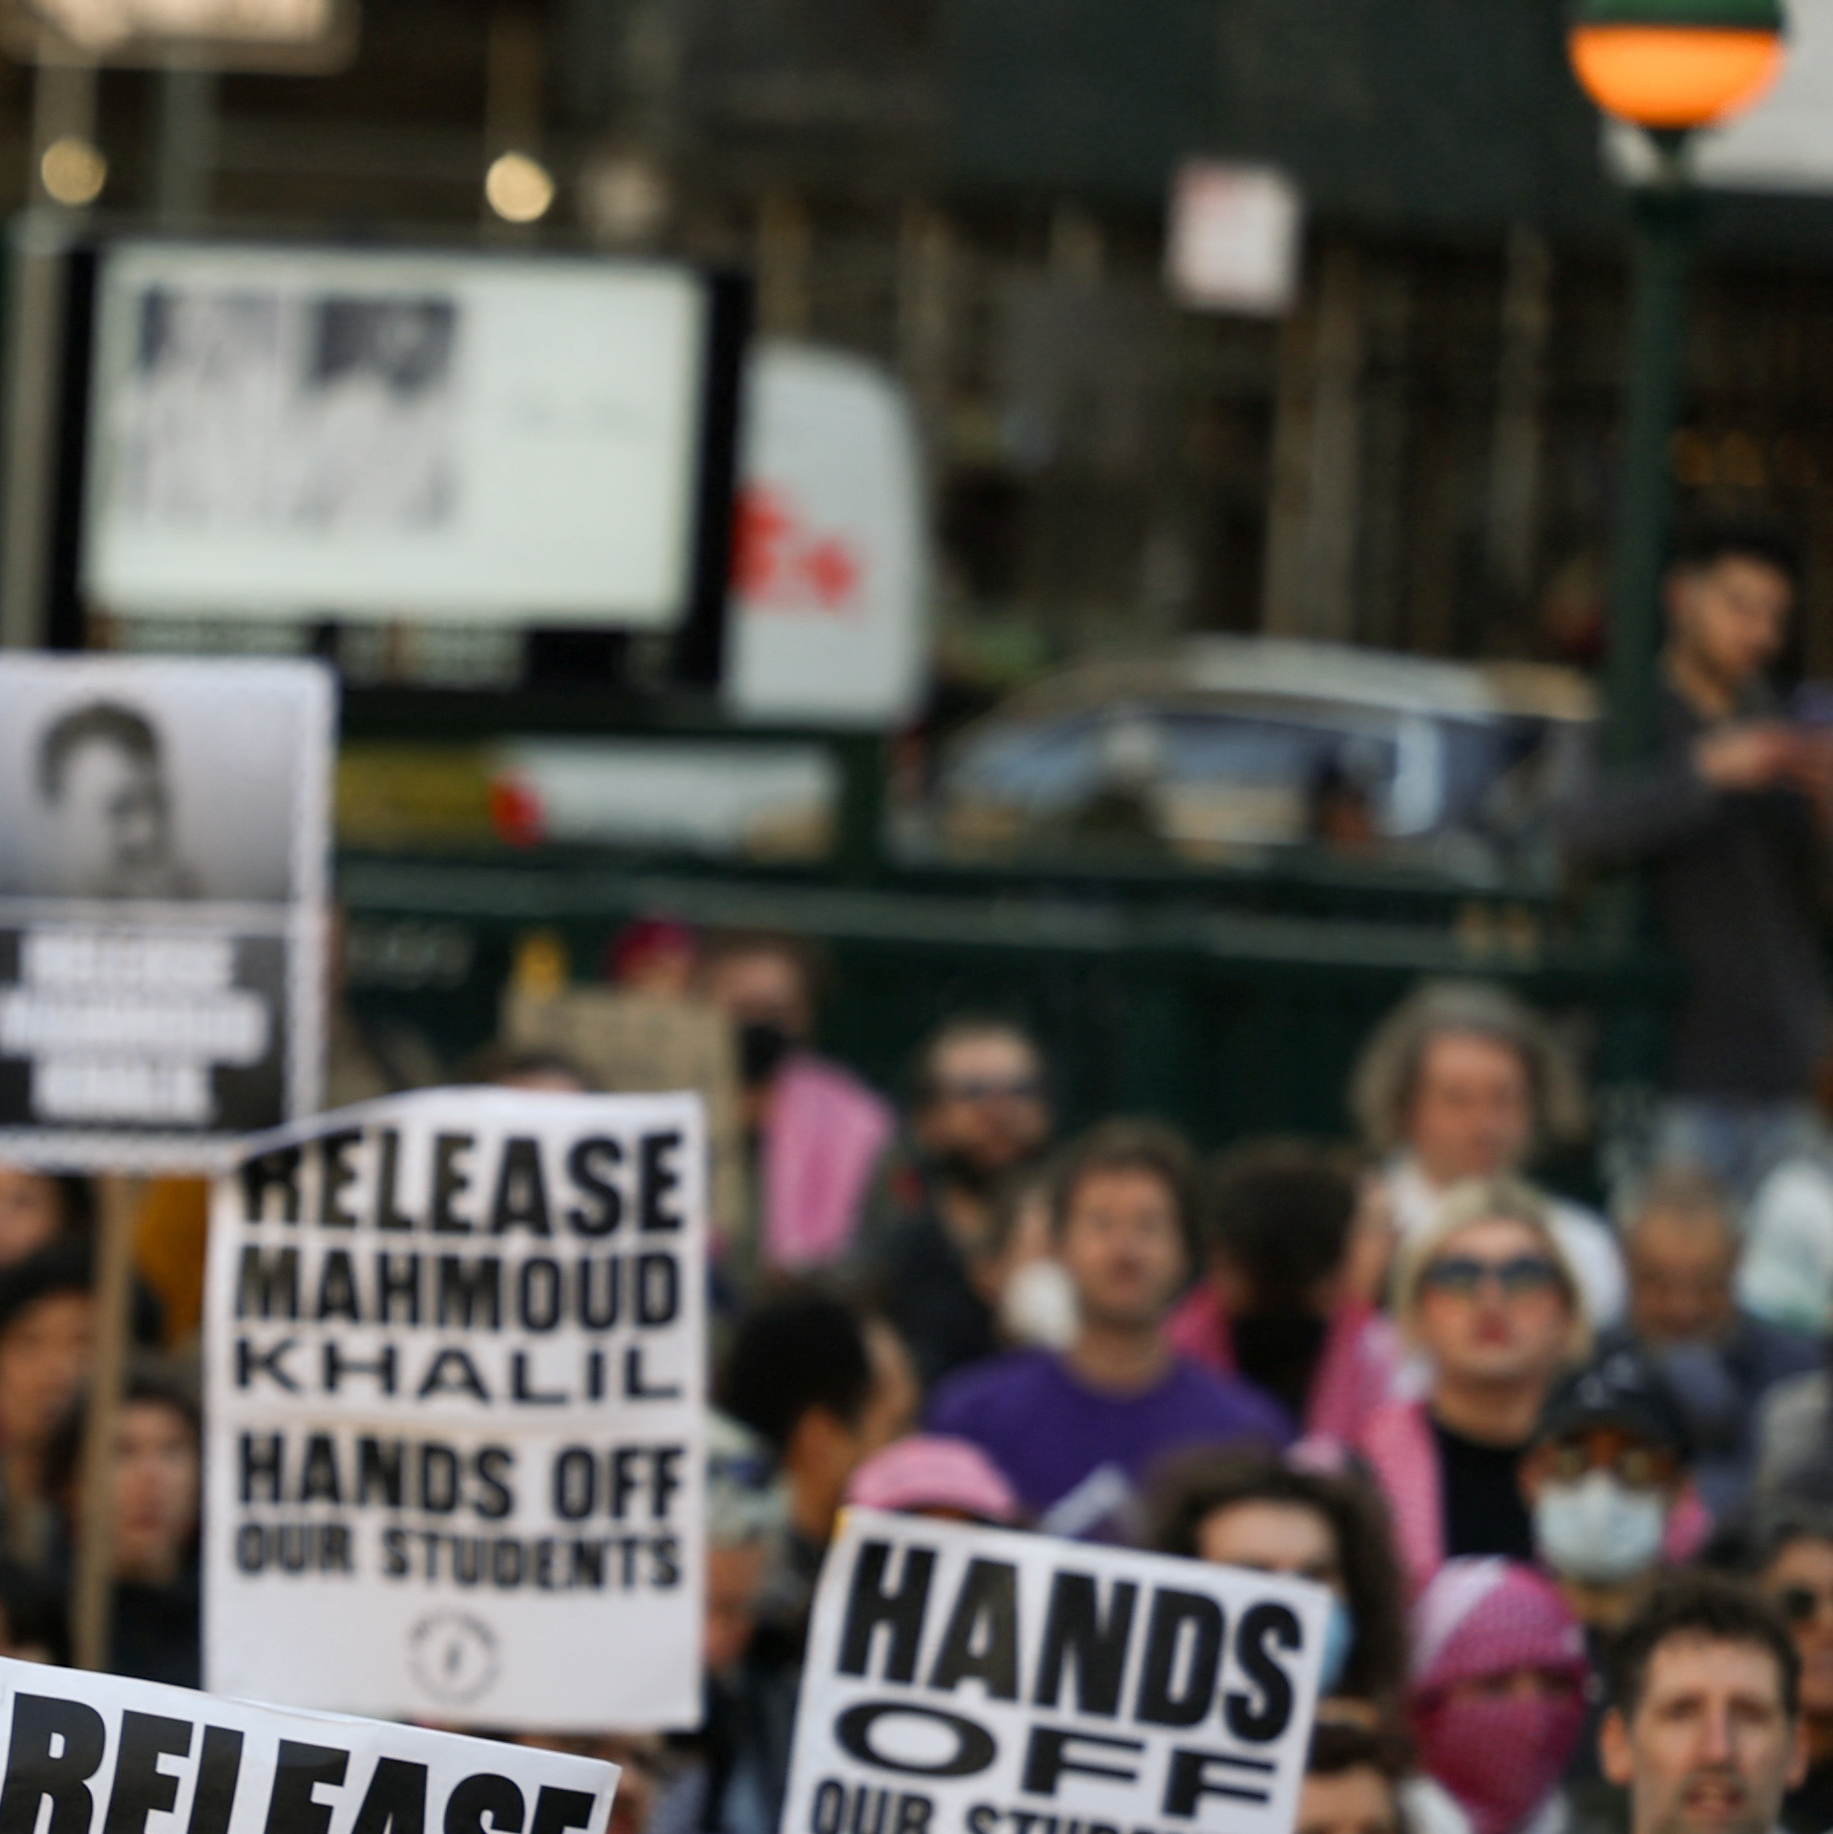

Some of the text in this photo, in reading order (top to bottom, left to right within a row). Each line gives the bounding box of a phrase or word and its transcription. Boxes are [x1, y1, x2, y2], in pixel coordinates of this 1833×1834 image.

[240, 1127, 683, 1239] RELEASE
[235, 1244, 682, 1334] MAHMOUD
[234, 1337, 681, 1408] KHALIL
[237, 1429, 685, 1522] HANDS OFF
[236, 1522, 682, 1591] OUR STUDENTS
[835, 1540, 1304, 1743] HANDS
[832, 1701, 1279, 1820] OFF
